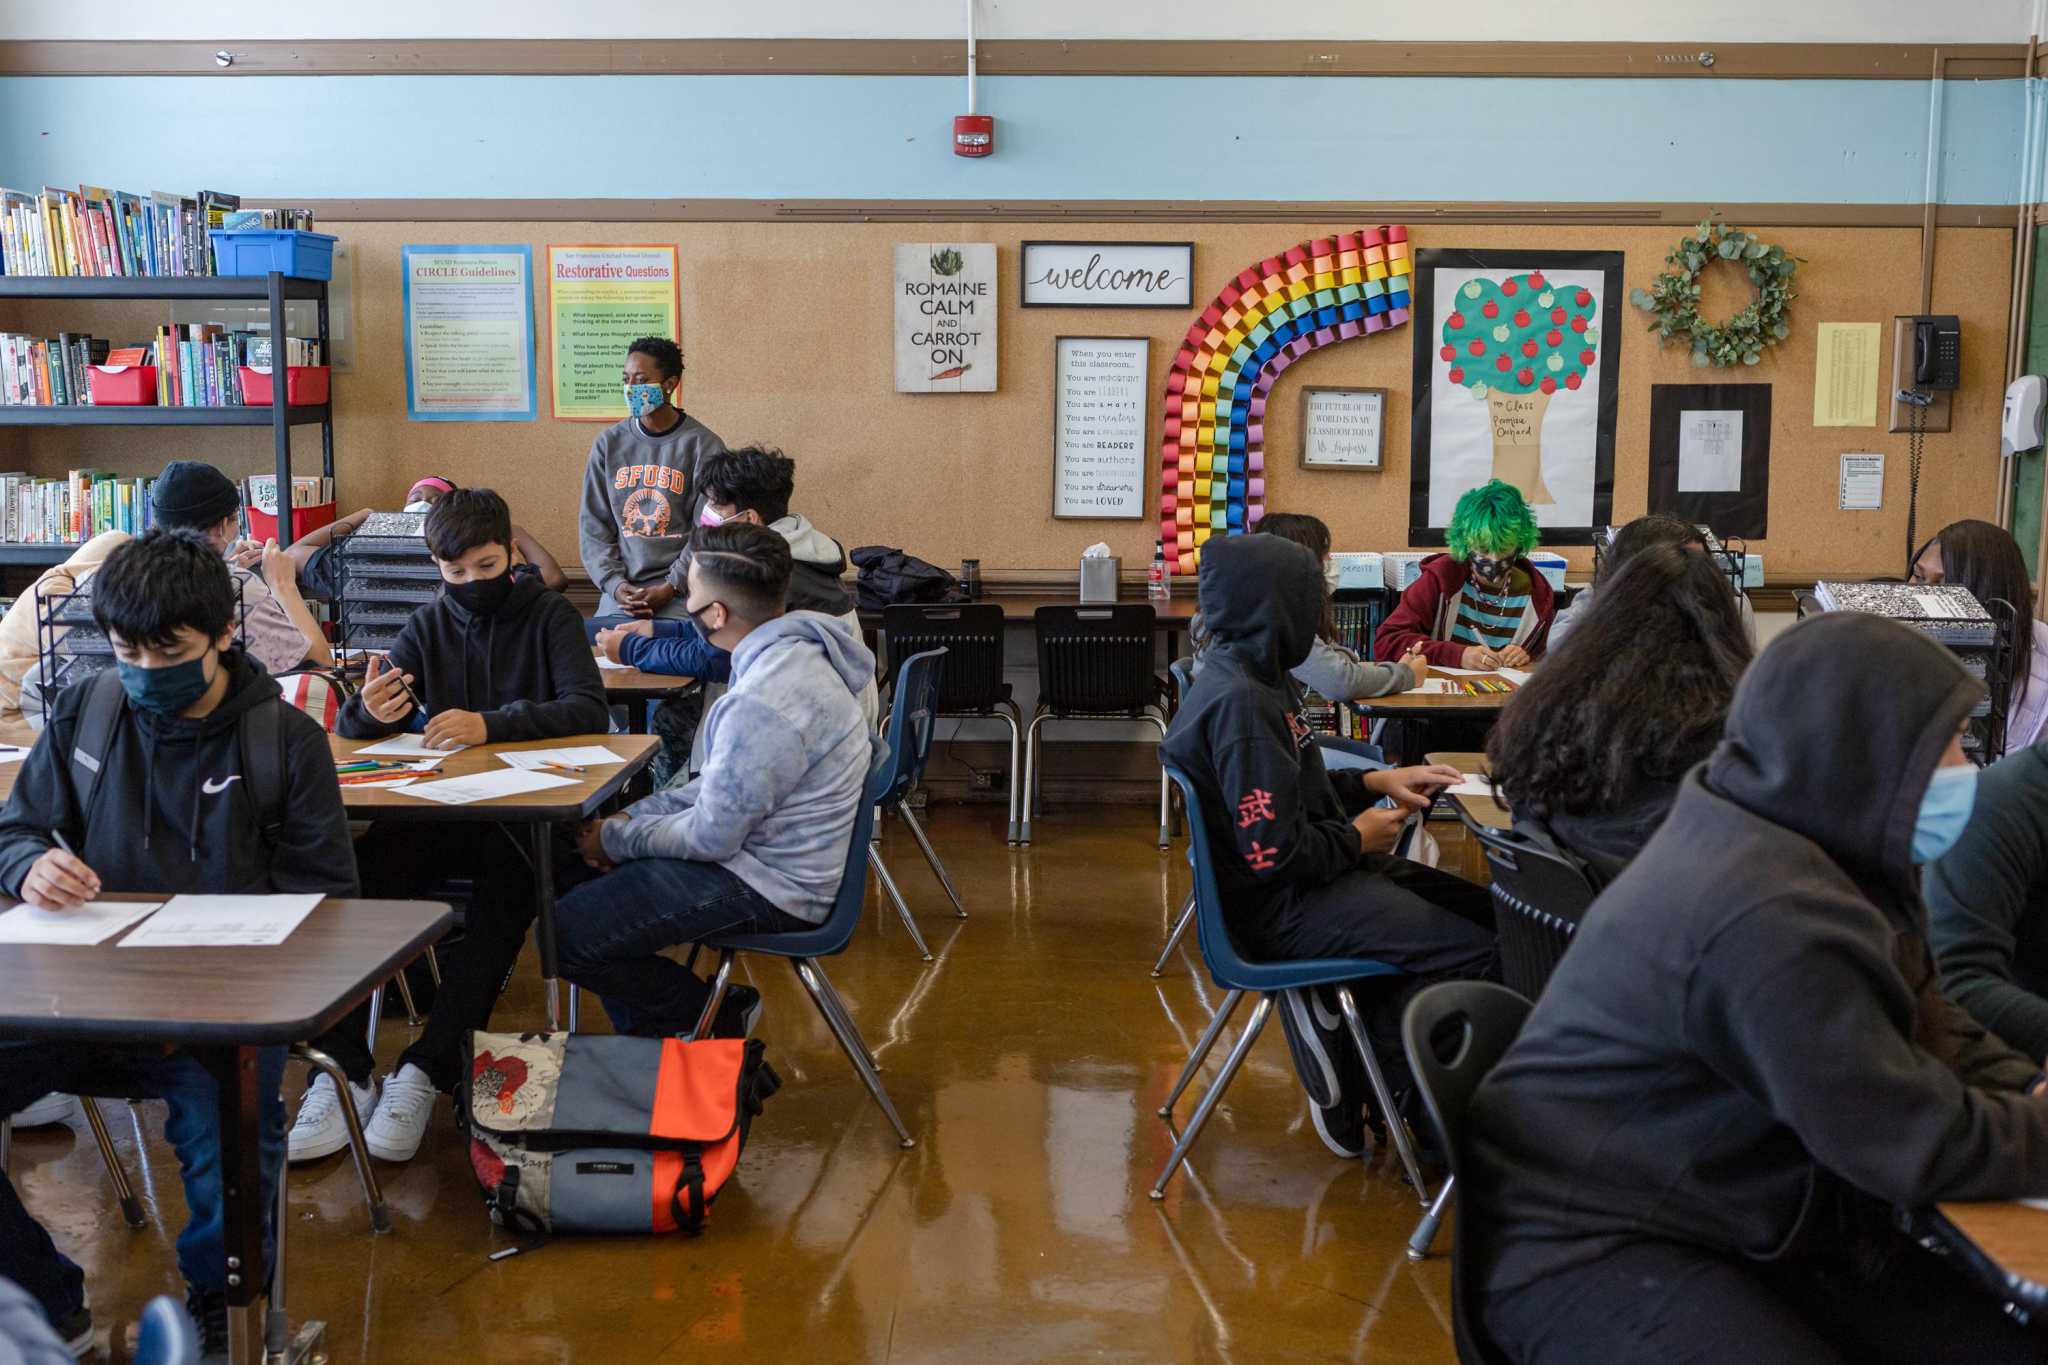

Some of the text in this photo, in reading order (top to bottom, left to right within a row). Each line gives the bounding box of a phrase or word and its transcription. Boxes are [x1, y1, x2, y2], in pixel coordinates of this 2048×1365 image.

[416, 266, 516, 277] CIRCLE Guidelines
[557, 262, 669, 278] Restorative Questions
[1029, 253, 1185, 292] welcome
[905, 282, 988, 296] ROMAINE
[919, 300, 974, 315] CALM
[937, 319, 958, 328] AND
[911, 332, 982, 346] CARROT
[931, 349, 963, 364] ON
[614, 464, 685, 494] SFUSD
[1096, 497, 1124, 505] LOVED
[1238, 789, 1278, 870] 武士
